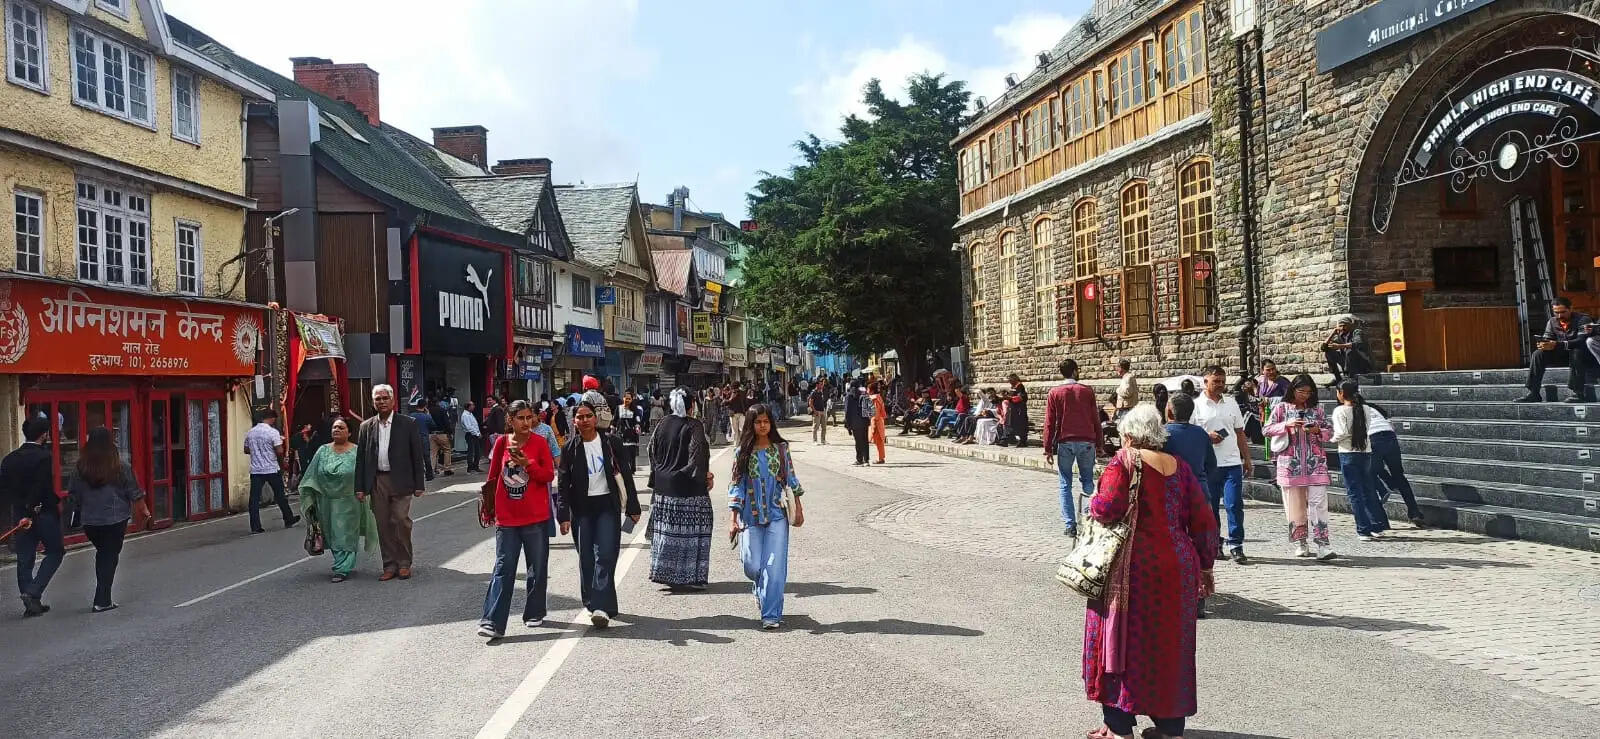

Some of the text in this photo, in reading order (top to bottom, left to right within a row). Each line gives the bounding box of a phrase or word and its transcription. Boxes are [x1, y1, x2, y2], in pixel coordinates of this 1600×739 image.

[1368, 8, 1428, 47] Municipal
[1422, 75, 1593, 152] SHIMLA HIGH END CAFÉ
[1457, 119, 1486, 142] SHIMLA
[1487, 106, 1509, 120] HIGH
[1511, 102, 1531, 113] END
[39, 287, 225, 343] अग्निशमन केन्द्र
[439, 291, 484, 331] PUMA
[89, 354, 188, 371] दूरभाष: 101, 2658976
[122, 339, 160, 355] माल रोड
[580, 340, 602, 353] Domino's
